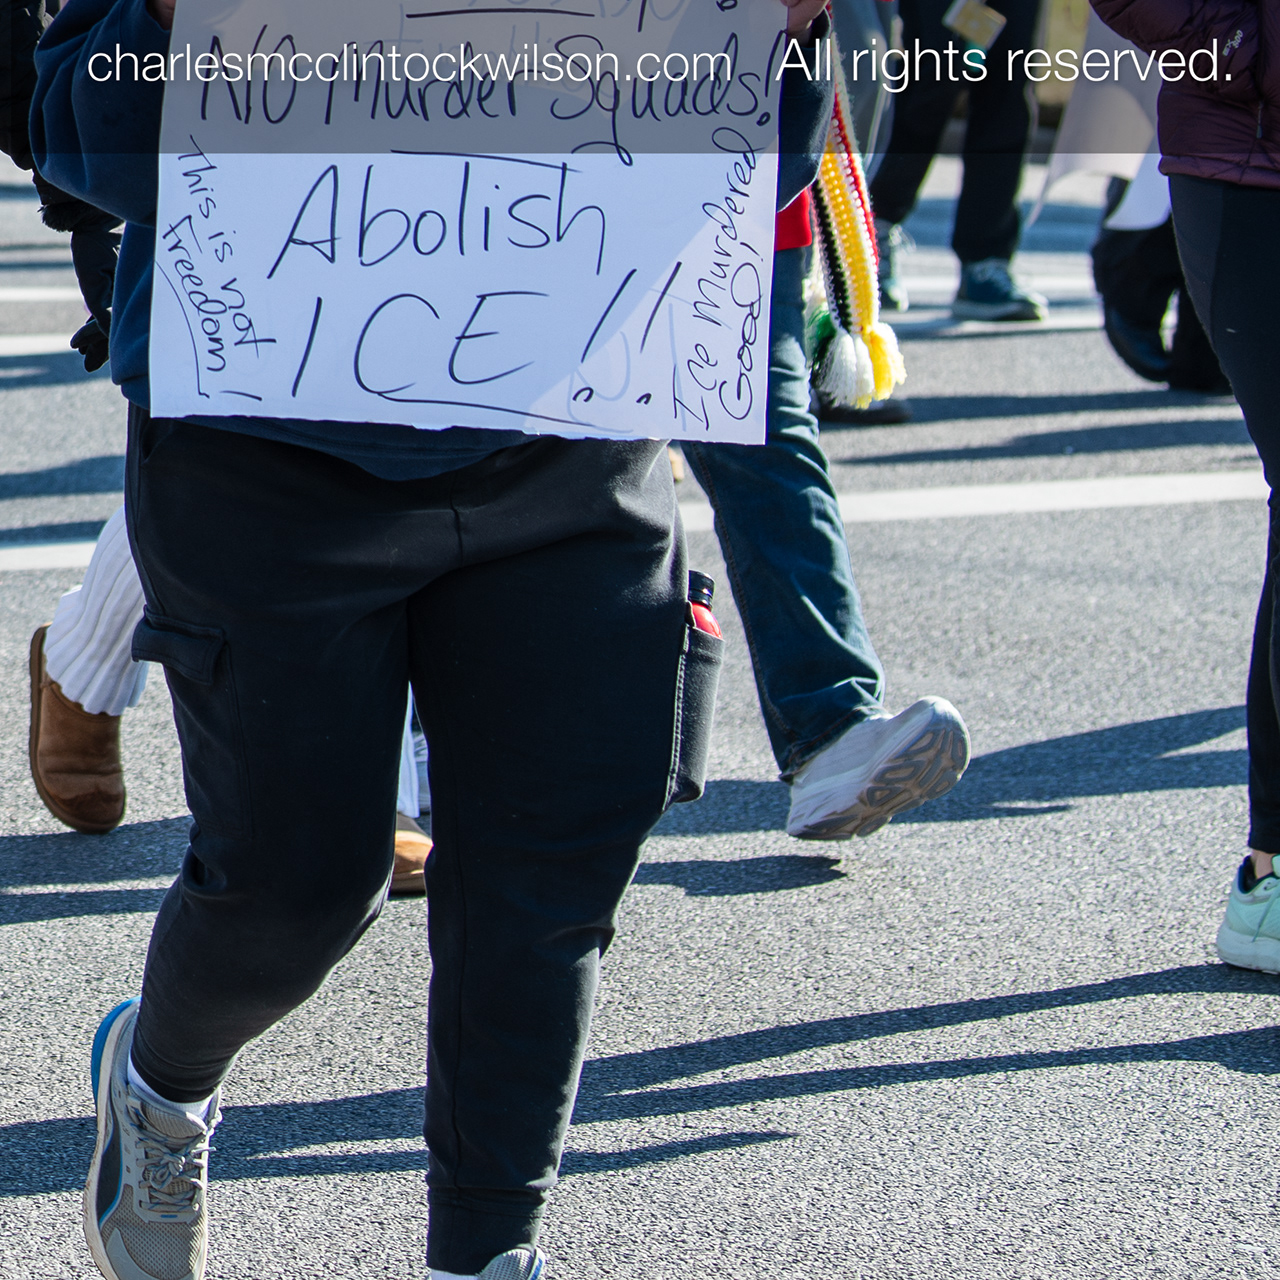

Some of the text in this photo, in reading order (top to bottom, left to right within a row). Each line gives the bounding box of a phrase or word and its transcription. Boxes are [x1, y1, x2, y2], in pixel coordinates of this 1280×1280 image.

[324, 37, 540, 125] Murder
[178, 134, 278, 360] This is not
[267, 160, 607, 279] Abolish
[691, 125, 767, 327] Murdered
